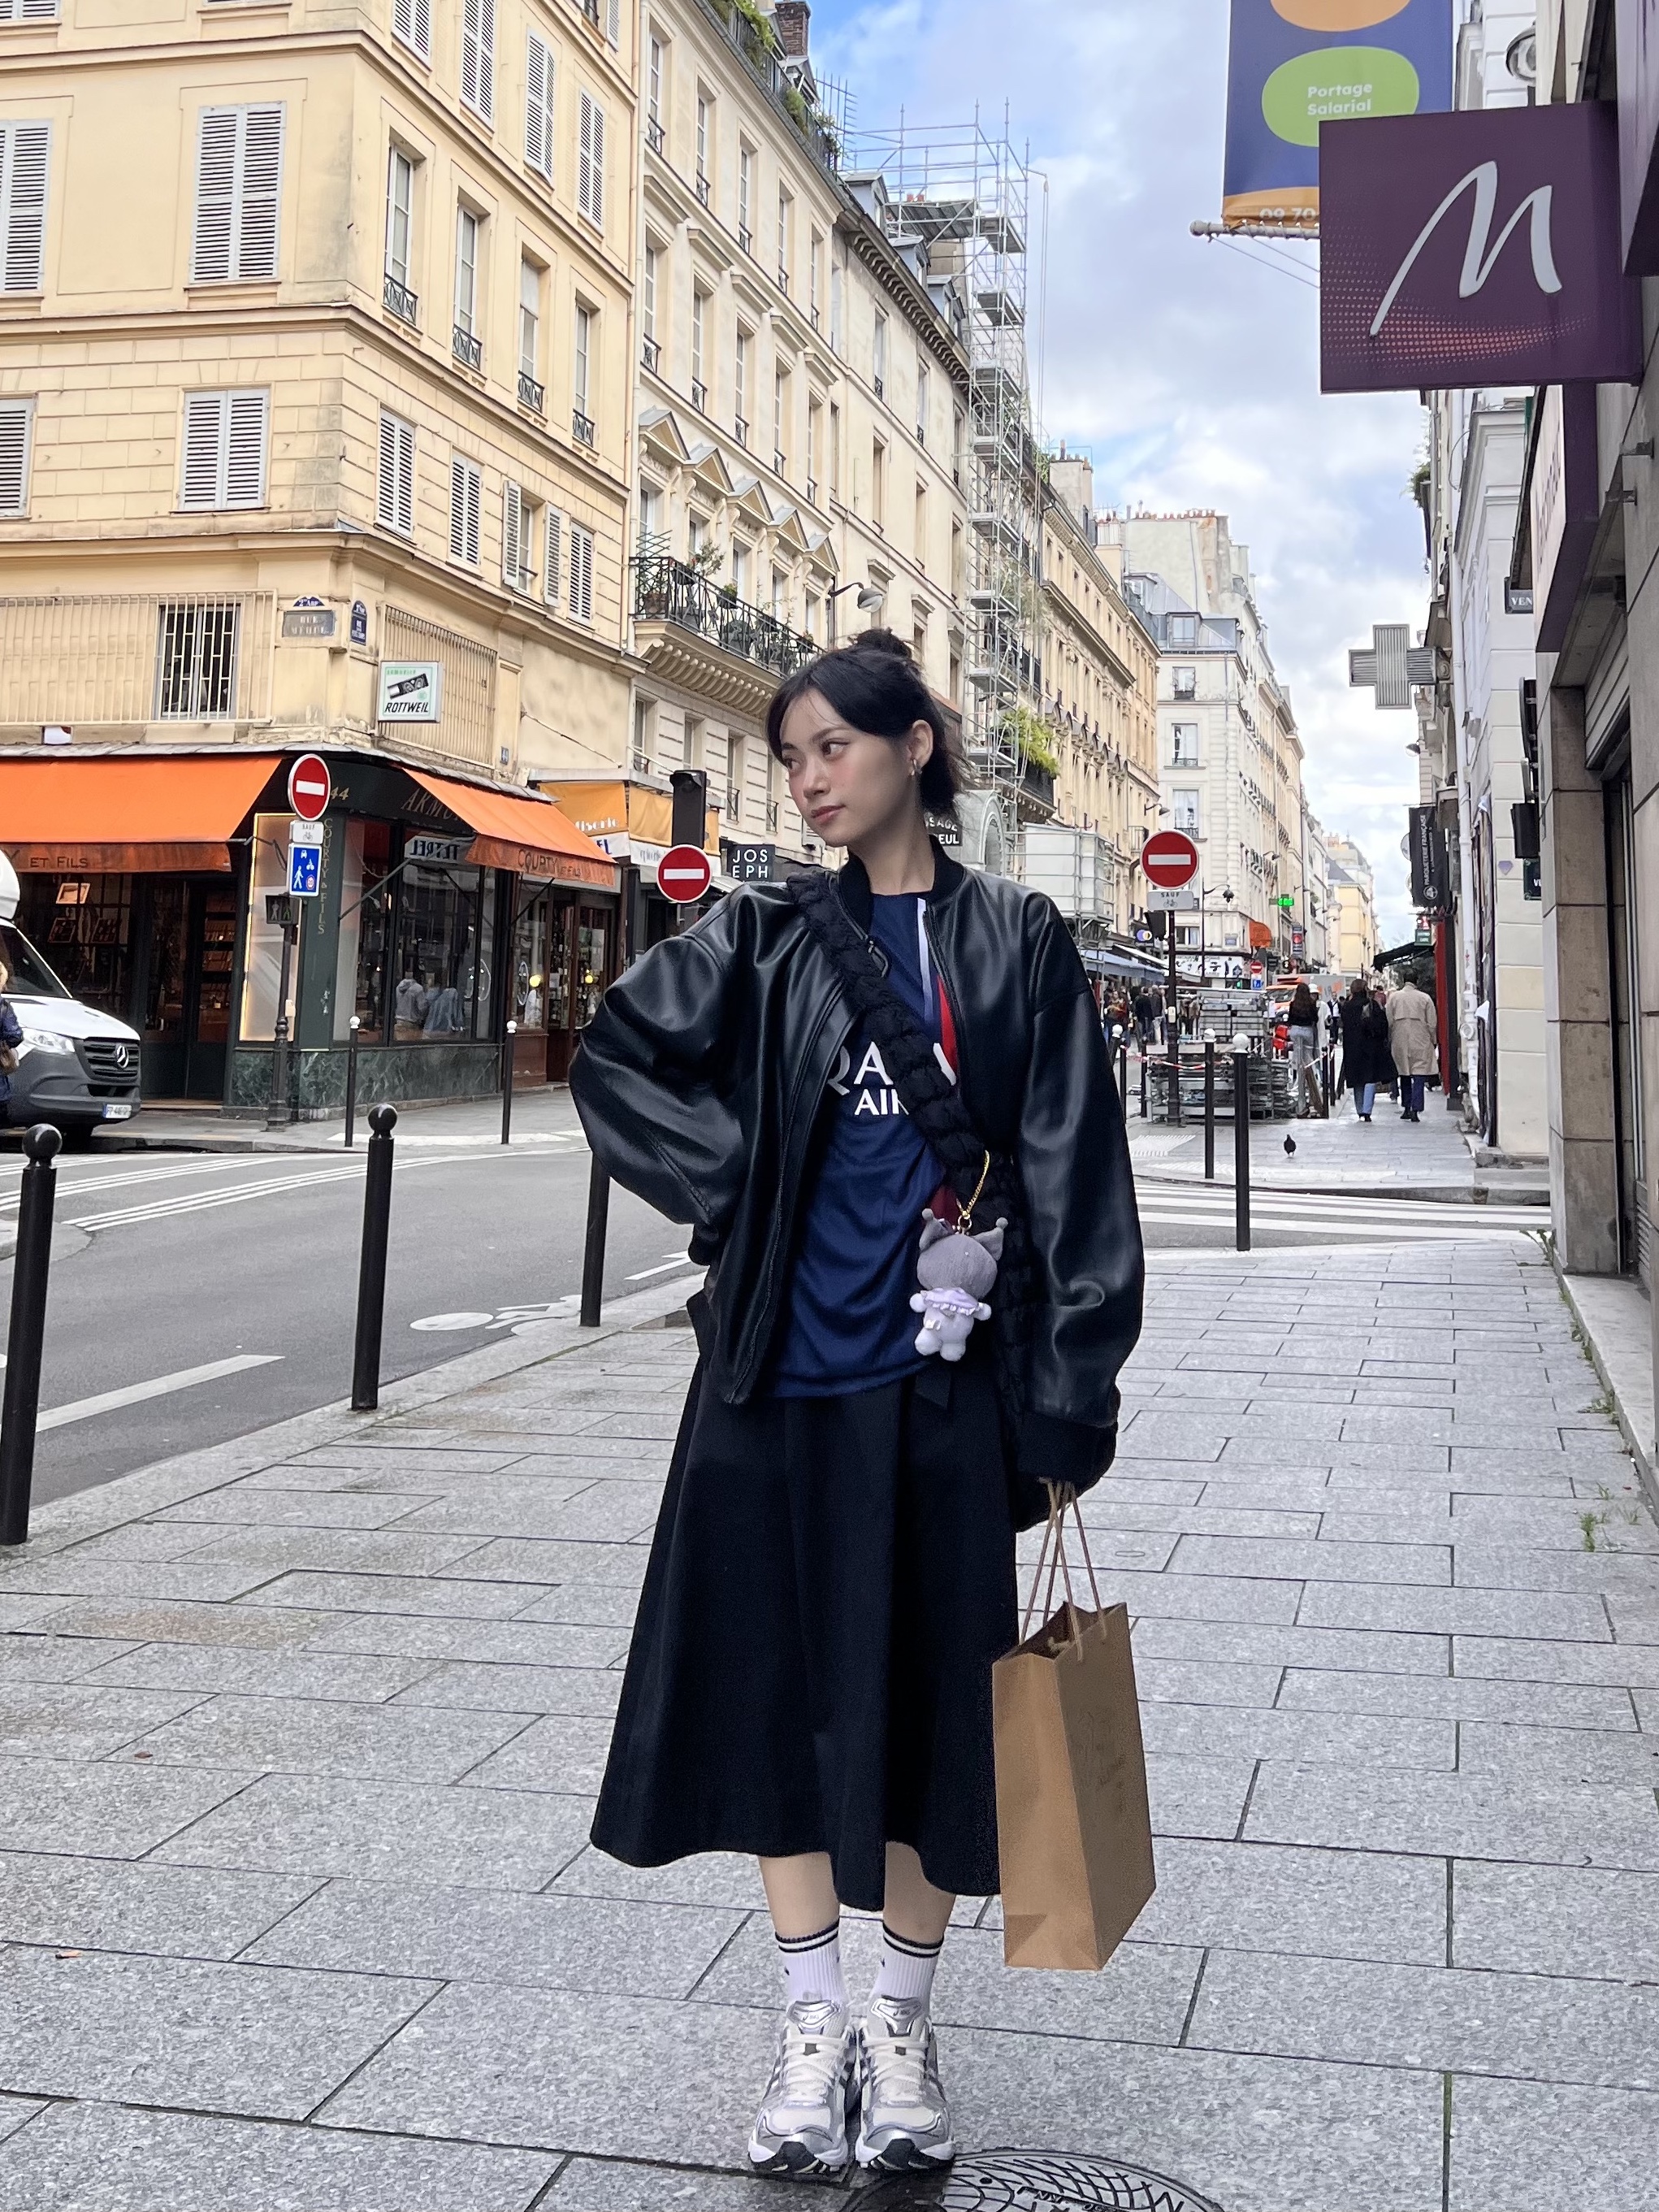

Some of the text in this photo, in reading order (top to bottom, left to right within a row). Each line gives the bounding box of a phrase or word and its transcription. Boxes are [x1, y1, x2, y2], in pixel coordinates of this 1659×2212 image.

[1307, 83, 1373, 98] Portage
[1307, 98, 1371, 115] Salarial
[1259, 207, 1316, 220] 09 70
[1369, 161, 1562, 335] M
[384, 701, 429, 713] ROTTWEIL
[331, 787, 349, 800] 44
[925, 817, 958, 832] SAGE
[322, 818, 333, 878] COURTY
[30, 857, 49, 868] ET
[57, 856, 89, 869] FILS
[732, 849, 769, 863] JOS
[732, 865, 769, 878] EPH
[318, 892, 327, 935] FILS
